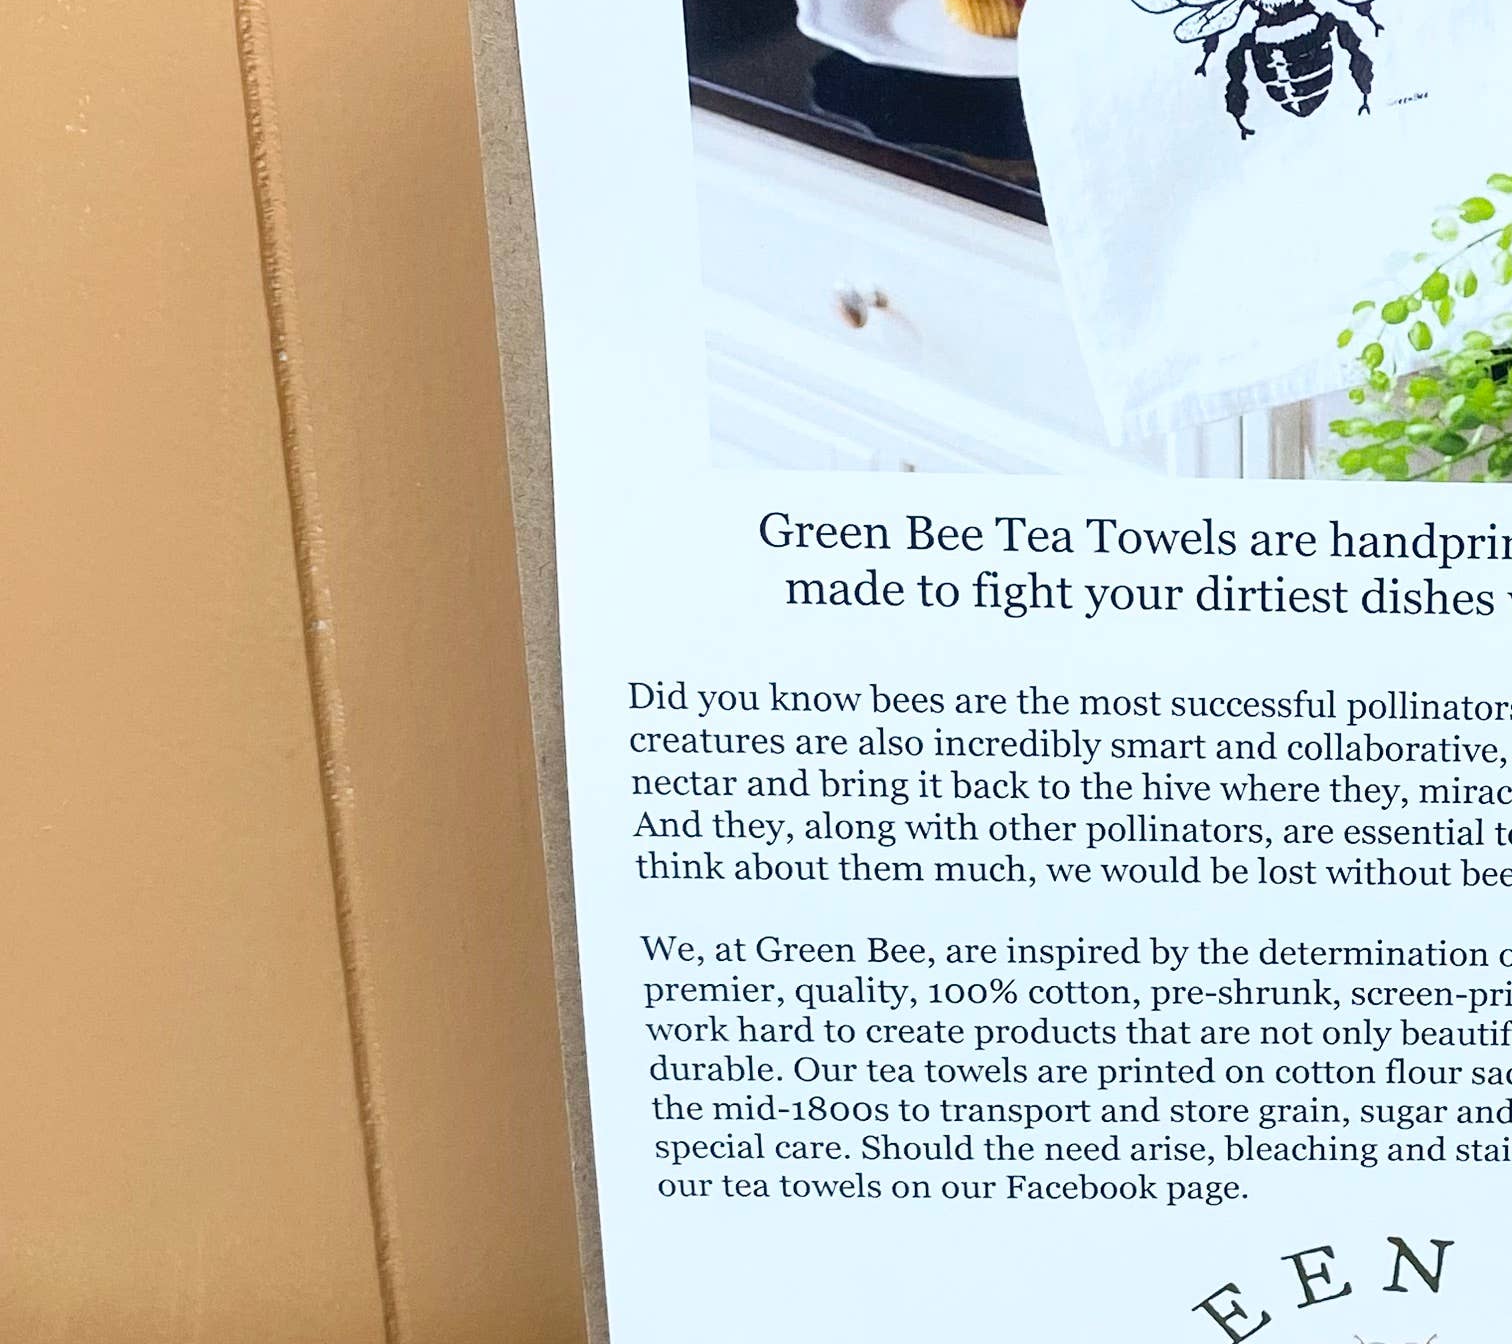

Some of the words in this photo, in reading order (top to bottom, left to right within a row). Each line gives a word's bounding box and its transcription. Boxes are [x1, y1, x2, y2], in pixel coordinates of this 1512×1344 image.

[759, 511, 892, 550] Green
[905, 514, 984, 552] Bee
[994, 516, 1075, 554] Tea
[1085, 517, 1237, 556] Towels
[1250, 530, 1317, 558] are
[785, 568, 905, 607] made
[916, 575, 960, 608] to
[971, 570, 1074, 619] fight
[1083, 584, 1184, 620] your
[1196, 574, 1349, 614] dirtiest
[1361, 576, 1495, 616] dishes
[627, 680, 689, 710] Did
[696, 690, 760, 718] you
[768, 681, 863, 713] know
[868, 683, 945, 714] bees
[955, 693, 1007, 715] are
[1016, 685, 1070, 716] the
[1079, 691, 1162, 717] most
[1171, 689, 1337, 719] successful
[629, 728, 785, 755] creatures
[795, 734, 848, 756] are
[858, 726, 924, 757] also
[933, 727, 1103, 766] incredibly
[1111, 734, 1207, 760] smart
[1216, 731, 1278, 761] and
[1287, 732, 1507, 769] collaborative,
[631, 770, 738, 797] nectar
[747, 767, 811, 797] and
[818, 768, 910, 806] bring
[918, 769, 943, 799] it
[950, 769, 1031, 800] back
[1037, 774, 1071, 800] to
[1079, 771, 1133, 801] the
[1141, 771, 1211, 802] hive
[1219, 772, 1320, 803] where
[1328, 774, 1409, 811] they,
[632, 809, 704, 839] And
[711, 809, 794, 847] they,
[805, 810, 897, 848] along
[904, 812, 979, 841] with
[988, 812, 1077, 842] other
[1085, 813, 1273, 850] pollinators,
[1283, 824, 1334, 845] are
[1343, 817, 1485, 846] essential
[634, 850, 726, 880] think
[734, 851, 830, 881] about
[837, 852, 925, 882] them
[933, 853, 1036, 888] much,
[1045, 863, 1092, 884] we
[1100, 855, 1202, 884] would
[1209, 855, 1249, 885] be
[1256, 856, 1318, 885] lost
[1325, 857, 1452, 887] without
[643, 975, 785, 1009] premier,
[795, 975, 918, 1011] quality,
[928, 977, 1018, 1005] 100%
[1028, 980, 1141, 1010] cotton,
[1150, 977, 1341, 1012] pre-shrunk,
[644, 1015, 730, 1043] work
[736, 1015, 816, 1043] hard
[823, 1019, 856, 1044] to
[865, 1020, 965, 1044] create
[973, 1016, 1117, 1051] products
[1125, 1017, 1192, 1045] that
[1200, 1025, 1251, 1045] are
[1259, 1021, 1313, 1046] not
[1322, 1018, 1393, 1052] only
[655, 1132, 766, 1166] special
[775, 1140, 851, 1160] care.
[861, 1133, 975, 1161] Should
[983, 1134, 1035, 1162] the
[1044, 1134, 1121, 1162] need
[1130, 1135, 1215, 1167] arise,
[1223, 1134, 1379, 1169] bleaching
[1387, 1135, 1447, 1162] and
